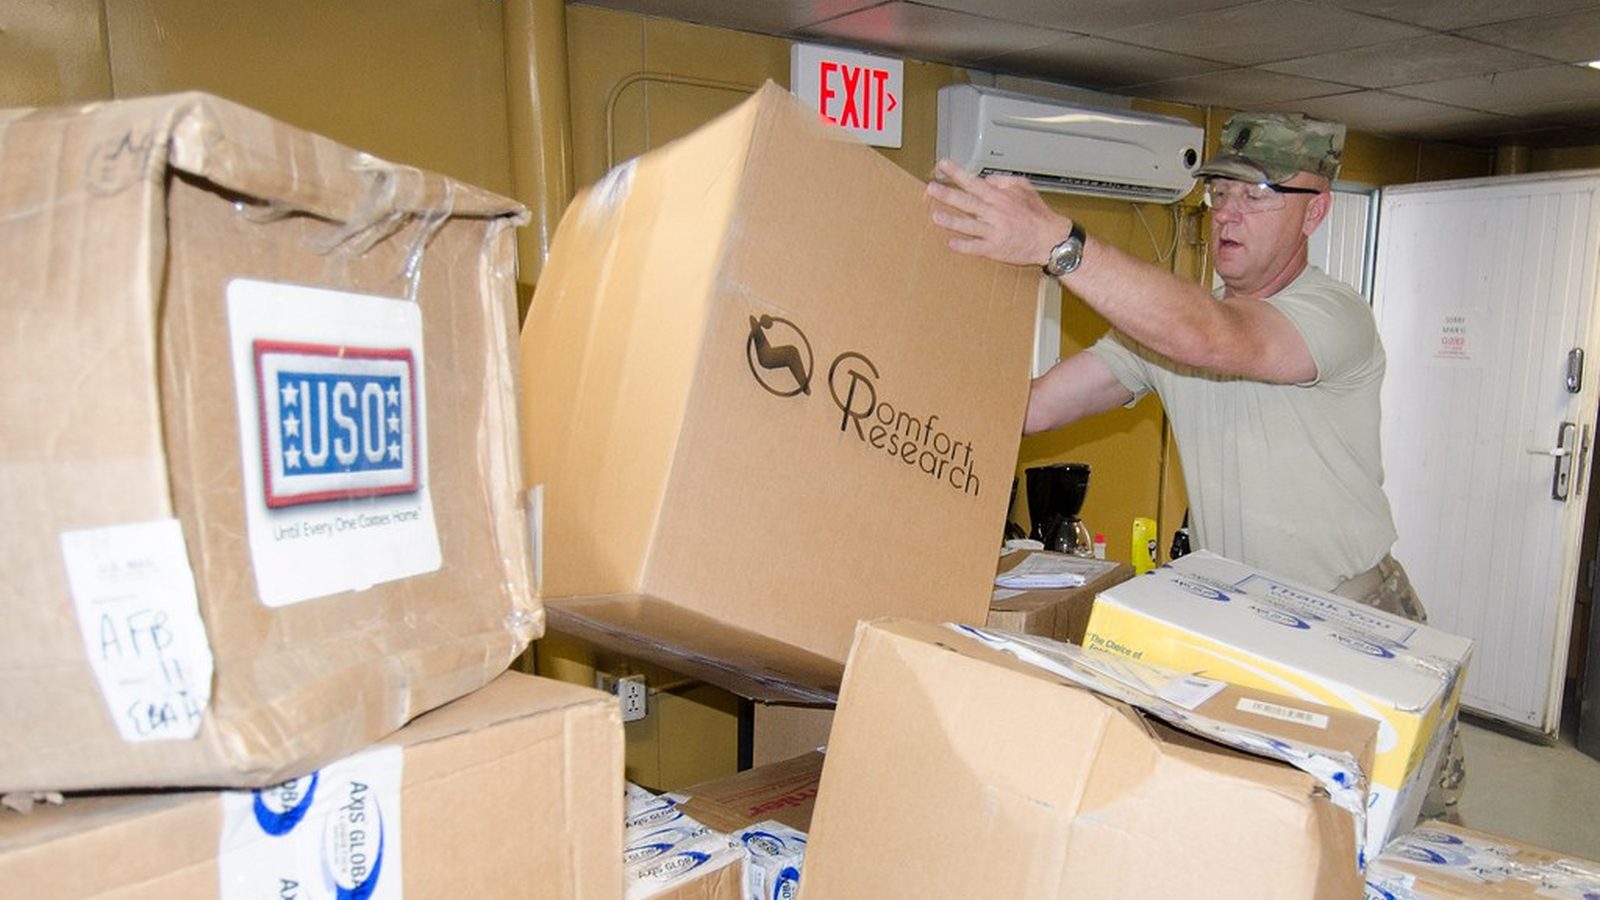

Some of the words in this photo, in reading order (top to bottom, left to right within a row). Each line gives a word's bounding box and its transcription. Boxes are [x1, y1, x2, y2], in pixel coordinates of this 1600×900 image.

[819, 61, 889, 131] EXIT
[300, 380, 387, 468] USO
[828, 351, 974, 467] Comfort
[840, 369, 980, 497] Research
[273, 519, 300, 541] Until
[303, 520, 334, 539] Every
[335, 516, 357, 532] One
[359, 512, 391, 528] Comes
[1269, 584, 1339, 612] Thank
[1348, 609, 1391, 629] You
[101, 609, 174, 661] AFB
[1105, 638, 1132, 657] Choice
[1132, 648, 1143, 660] of
[339, 781, 369, 824] AXIS
